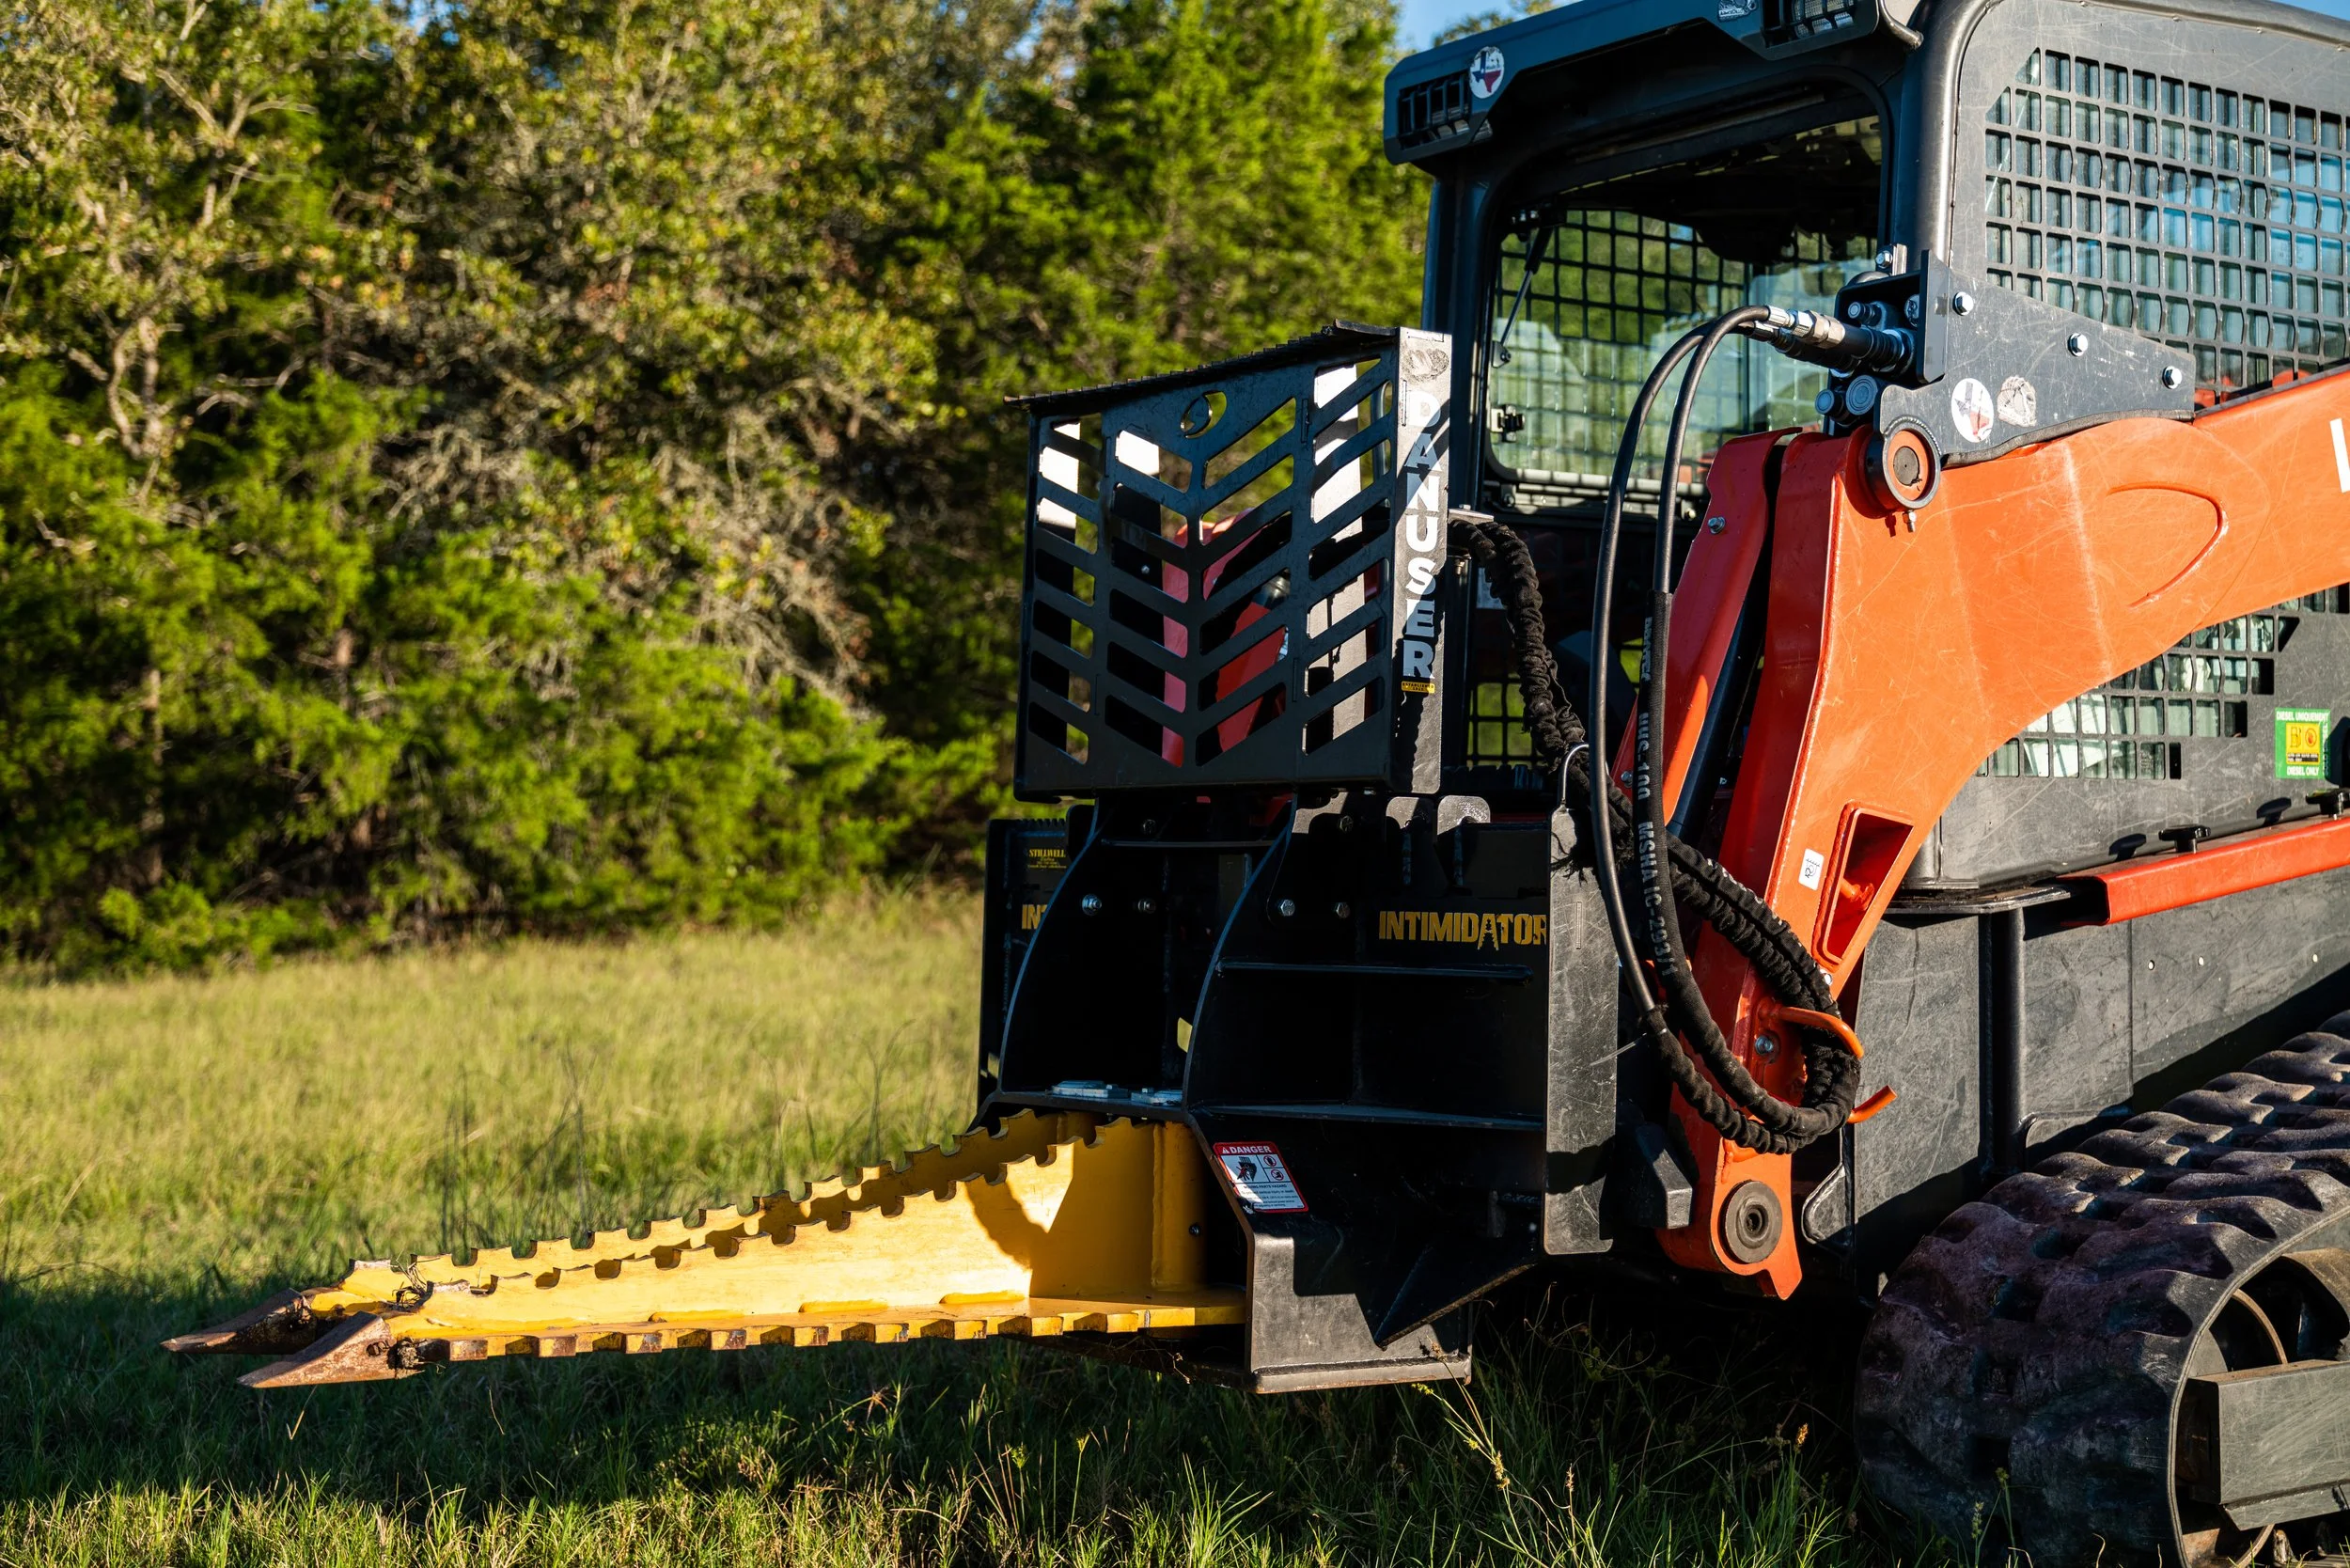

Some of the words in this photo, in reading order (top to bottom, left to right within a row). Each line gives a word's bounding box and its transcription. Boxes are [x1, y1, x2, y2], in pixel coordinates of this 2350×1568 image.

[1402, 390, 1442, 680] DANUSER
[1638, 820, 1658, 884] MSHA
[1378, 910, 1547, 951] INTIMIDATOR
[1230, 1145, 1272, 1153] DANGER
